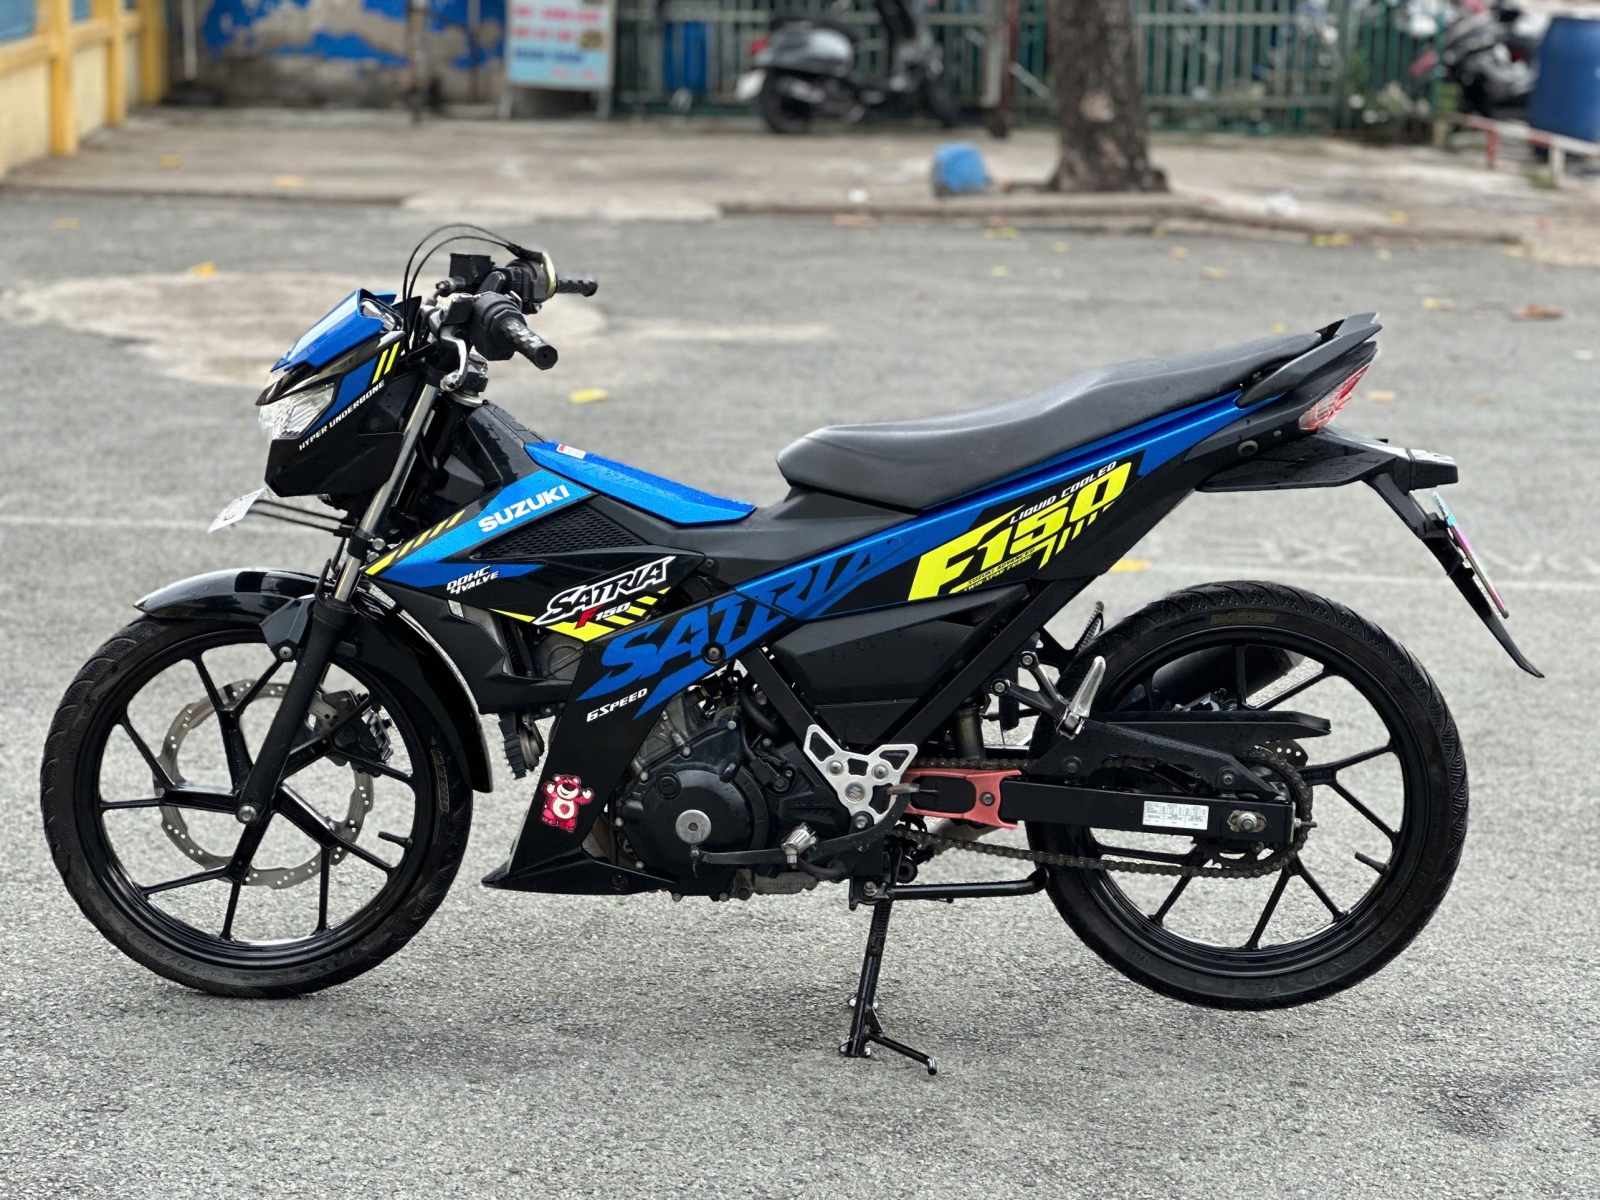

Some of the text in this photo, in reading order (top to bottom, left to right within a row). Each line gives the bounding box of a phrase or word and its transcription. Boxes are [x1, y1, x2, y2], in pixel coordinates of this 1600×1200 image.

[299, 379, 386, 451] HYPER UNDERBONE
[478, 484, 571, 533] SUZUKI
[1009, 460, 1117, 525] LIQUID COOLED
[907, 461, 1132, 601] F150
[446, 564, 491, 591] DOHC
[532, 555, 677, 625] SATRIA
[586, 687, 648, 723] 6SPEED
